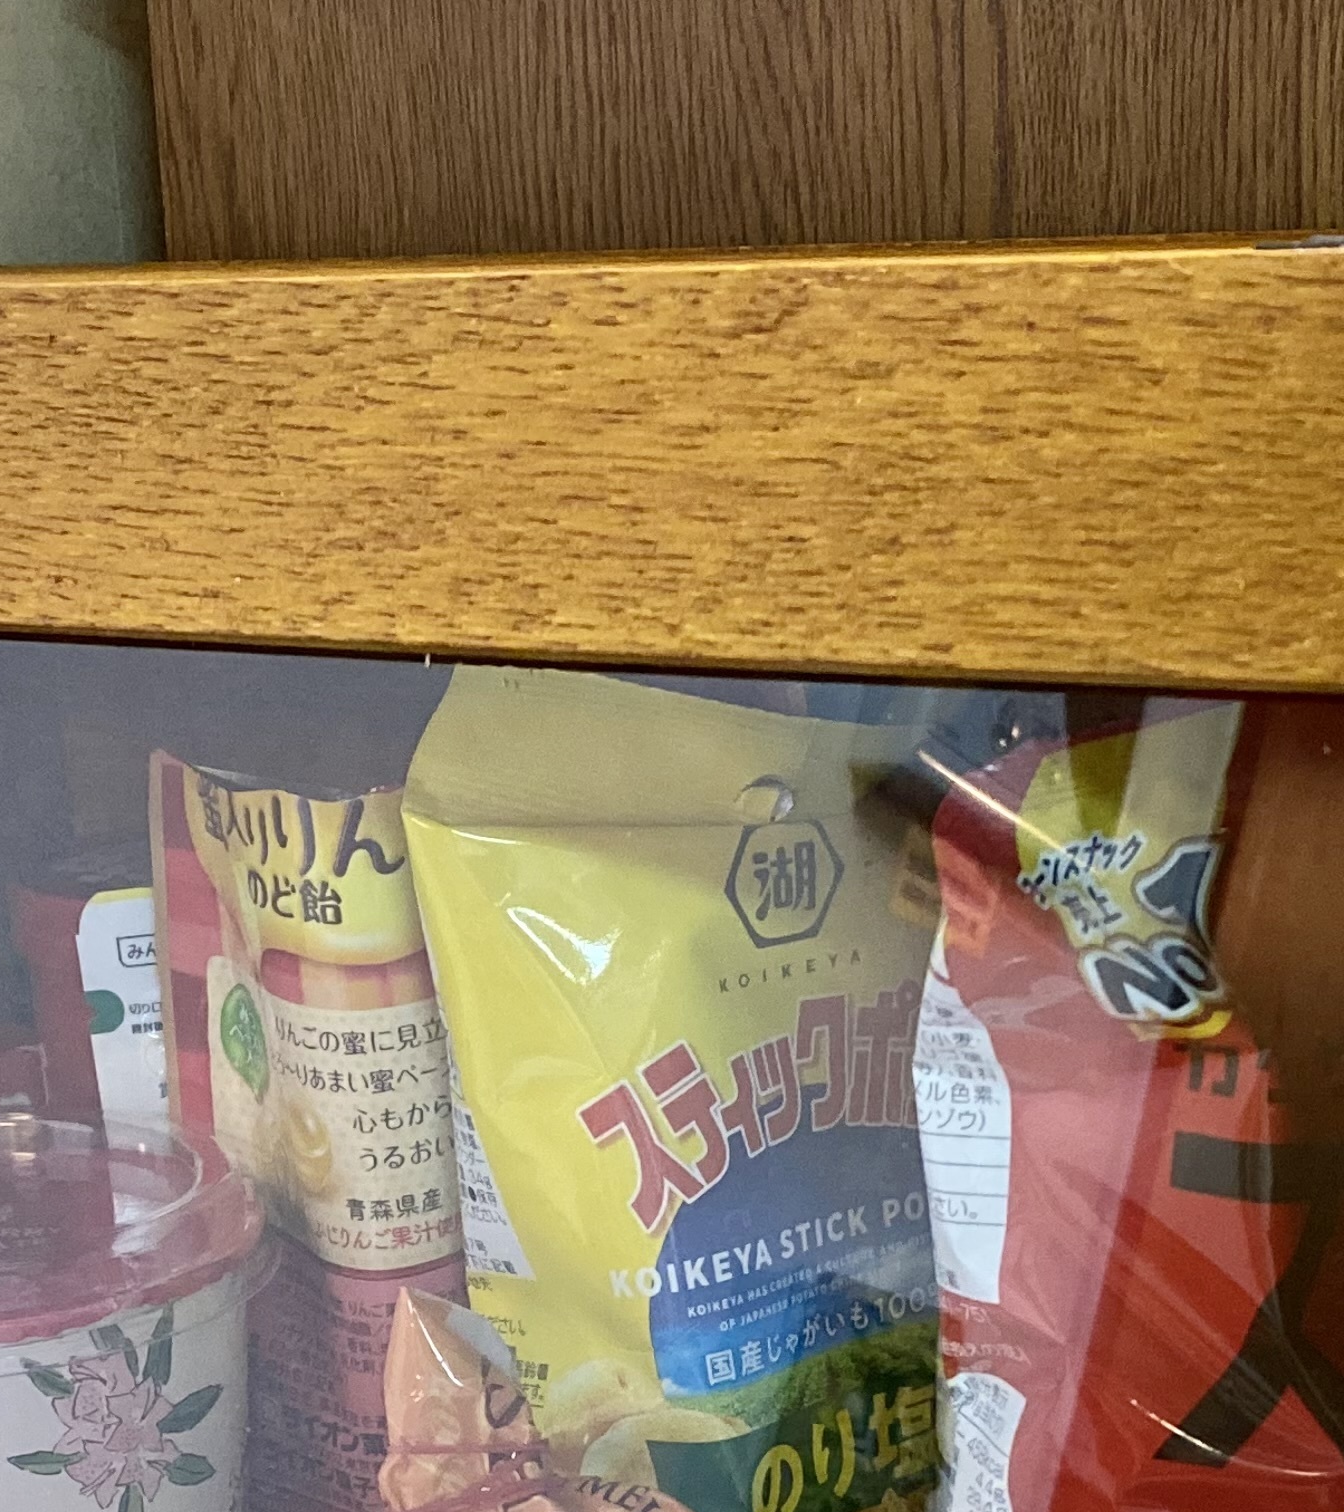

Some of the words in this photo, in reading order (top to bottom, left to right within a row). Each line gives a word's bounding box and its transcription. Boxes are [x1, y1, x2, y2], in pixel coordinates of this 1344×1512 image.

[247, 869, 344, 926] のど飴
[718, 950, 862, 995] KOIKEYA
[352, 1094, 453, 1135] 心もから
[358, 1135, 456, 1173] うるおい
[345, 1188, 444, 1222] 青森県産
[609, 1238, 773, 1300] KOIKEYA
[779, 1204, 869, 1260] STICK
[687, 1295, 745, 1319] KOIKEYA
[746, 1285, 769, 1302] HAS
[719, 1319, 737, 1333] OF
